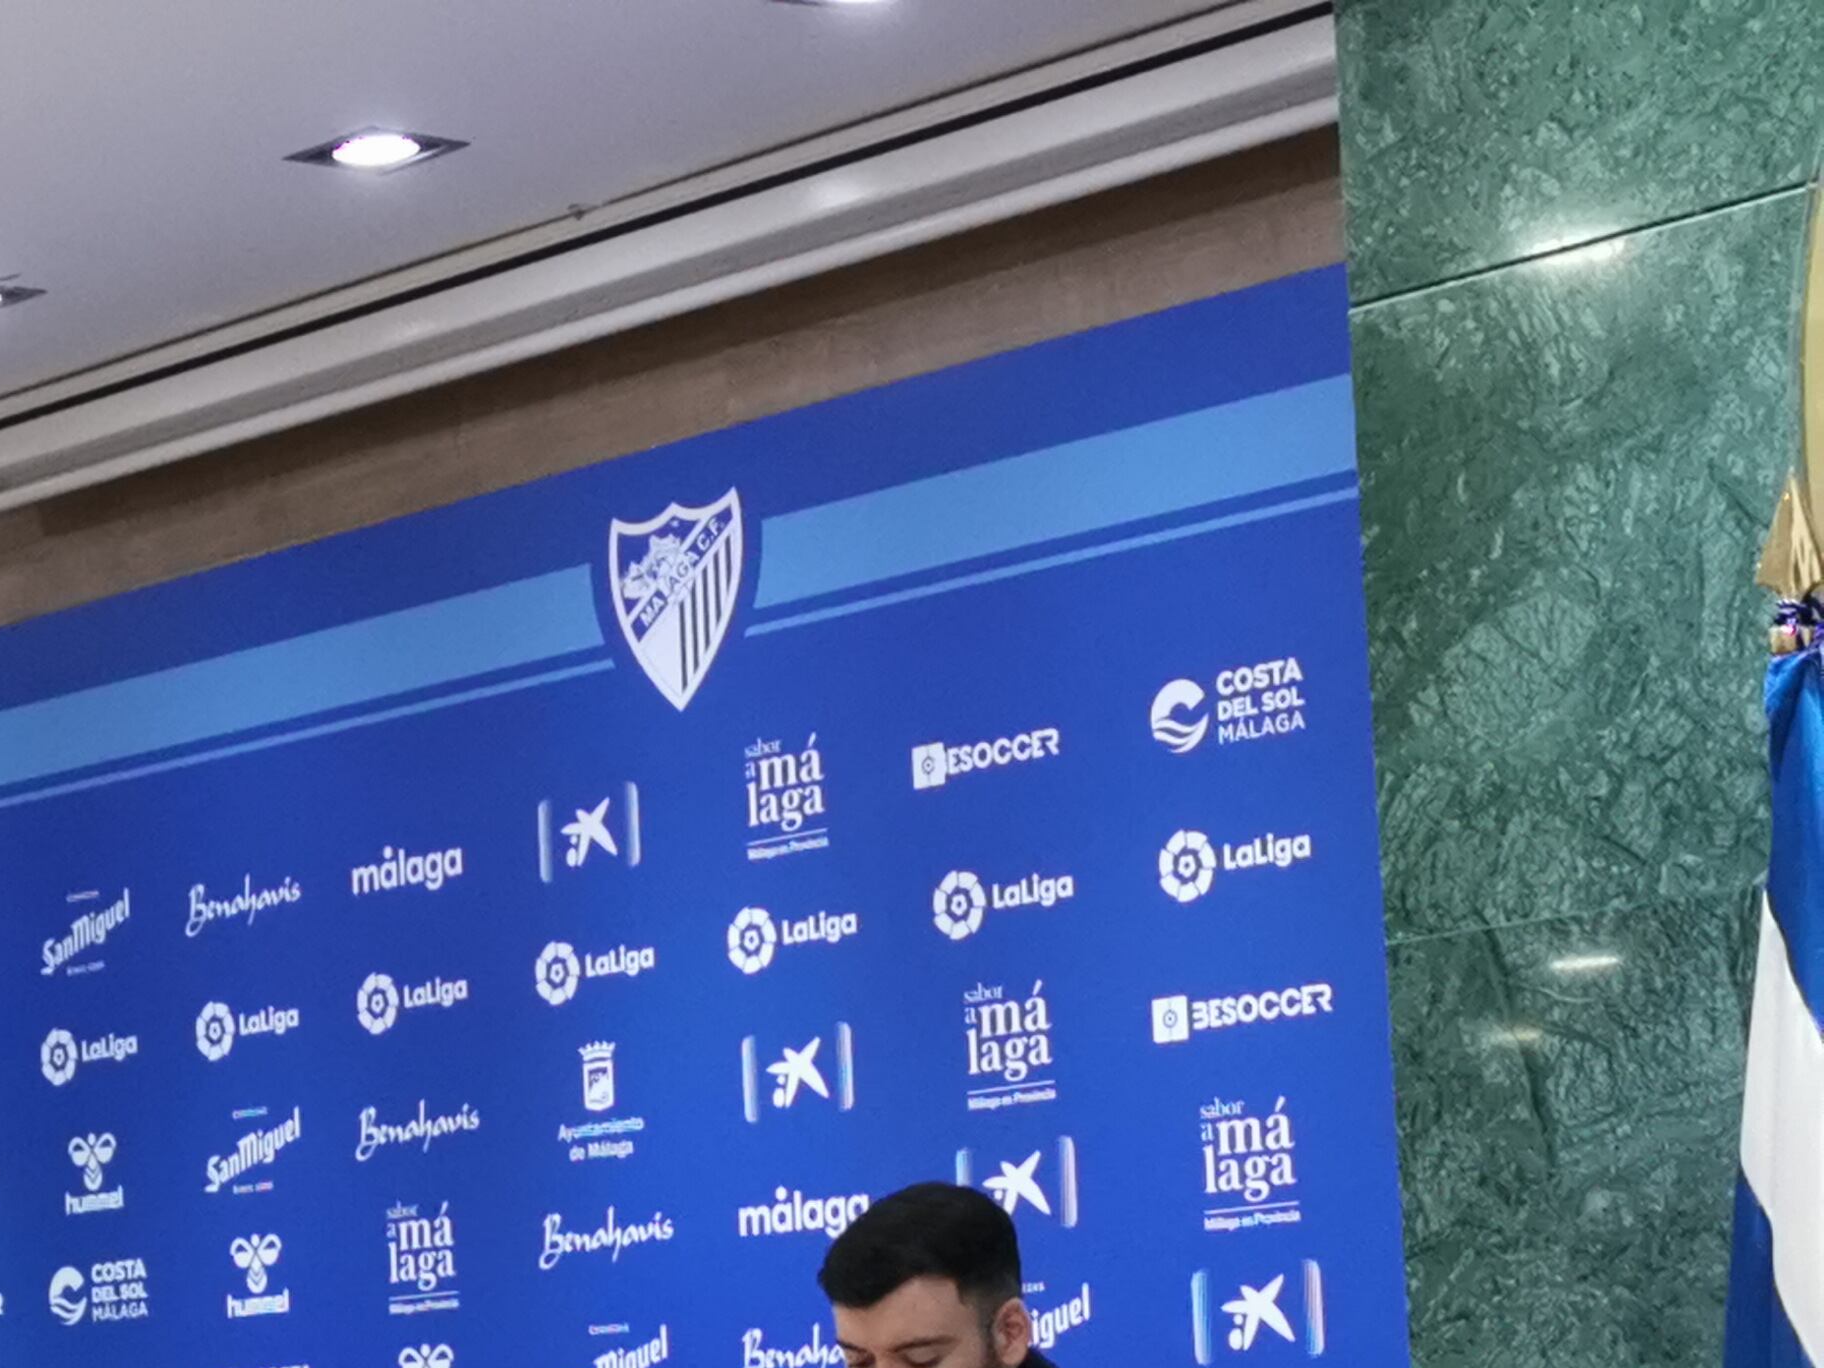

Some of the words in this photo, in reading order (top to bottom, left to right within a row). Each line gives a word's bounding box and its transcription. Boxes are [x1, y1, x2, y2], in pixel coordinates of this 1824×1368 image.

[1216, 657, 1303, 696] COSTA
[1217, 695, 1258, 721] DEL
[1261, 686, 1305, 713] SOL
[1217, 709, 1305, 744] MÁLAGA
[757, 733, 824, 791] má
[747, 781, 825, 832] laga
[1223, 833, 1311, 870] LaLiga
[992, 873, 1074, 909] LaLiga
[782, 911, 857, 945] LaLiga
[585, 944, 655, 978] LaLiga
[403, 977, 468, 1009] LaLiga
[978, 979, 1051, 1038] má
[1191, 983, 1333, 1030] BESOCCER
[239, 1006, 299, 1036] LaLiga
[81, 1033, 138, 1062] LaLiga
[966, 1028, 1052, 1082] laga
[1200, 1097, 1244, 1119] sabor
[1215, 1096, 1295, 1156] má
[1203, 1144, 1296, 1203] laga
[65, 1185, 124, 1215] hummel
[398, 1201, 454, 1251] má
[91, 1258, 147, 1284] COSTA
[388, 1241, 456, 1291] laga
[91, 1284, 118, 1304] DEL
[120, 1282, 147, 1300] SOL
[227, 1288, 290, 1318] hummel
